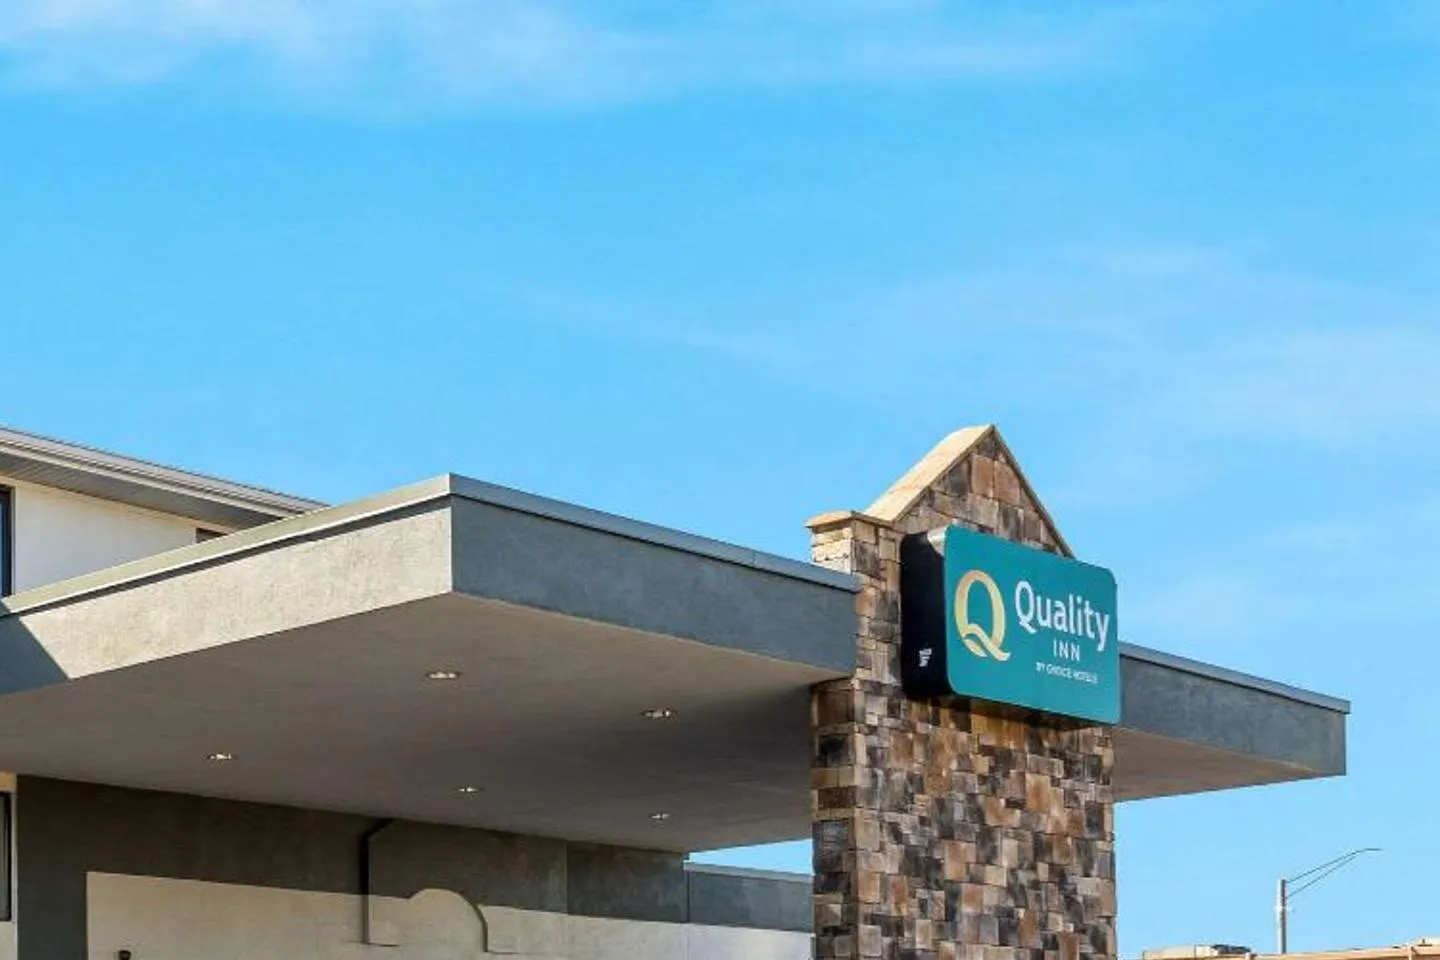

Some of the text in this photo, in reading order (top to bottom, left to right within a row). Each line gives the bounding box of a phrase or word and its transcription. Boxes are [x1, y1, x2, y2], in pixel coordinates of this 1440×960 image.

[954, 569, 1012, 661] Q
[1015, 580, 1110, 652] Quality
[1053, 639, 1081, 662] INN
